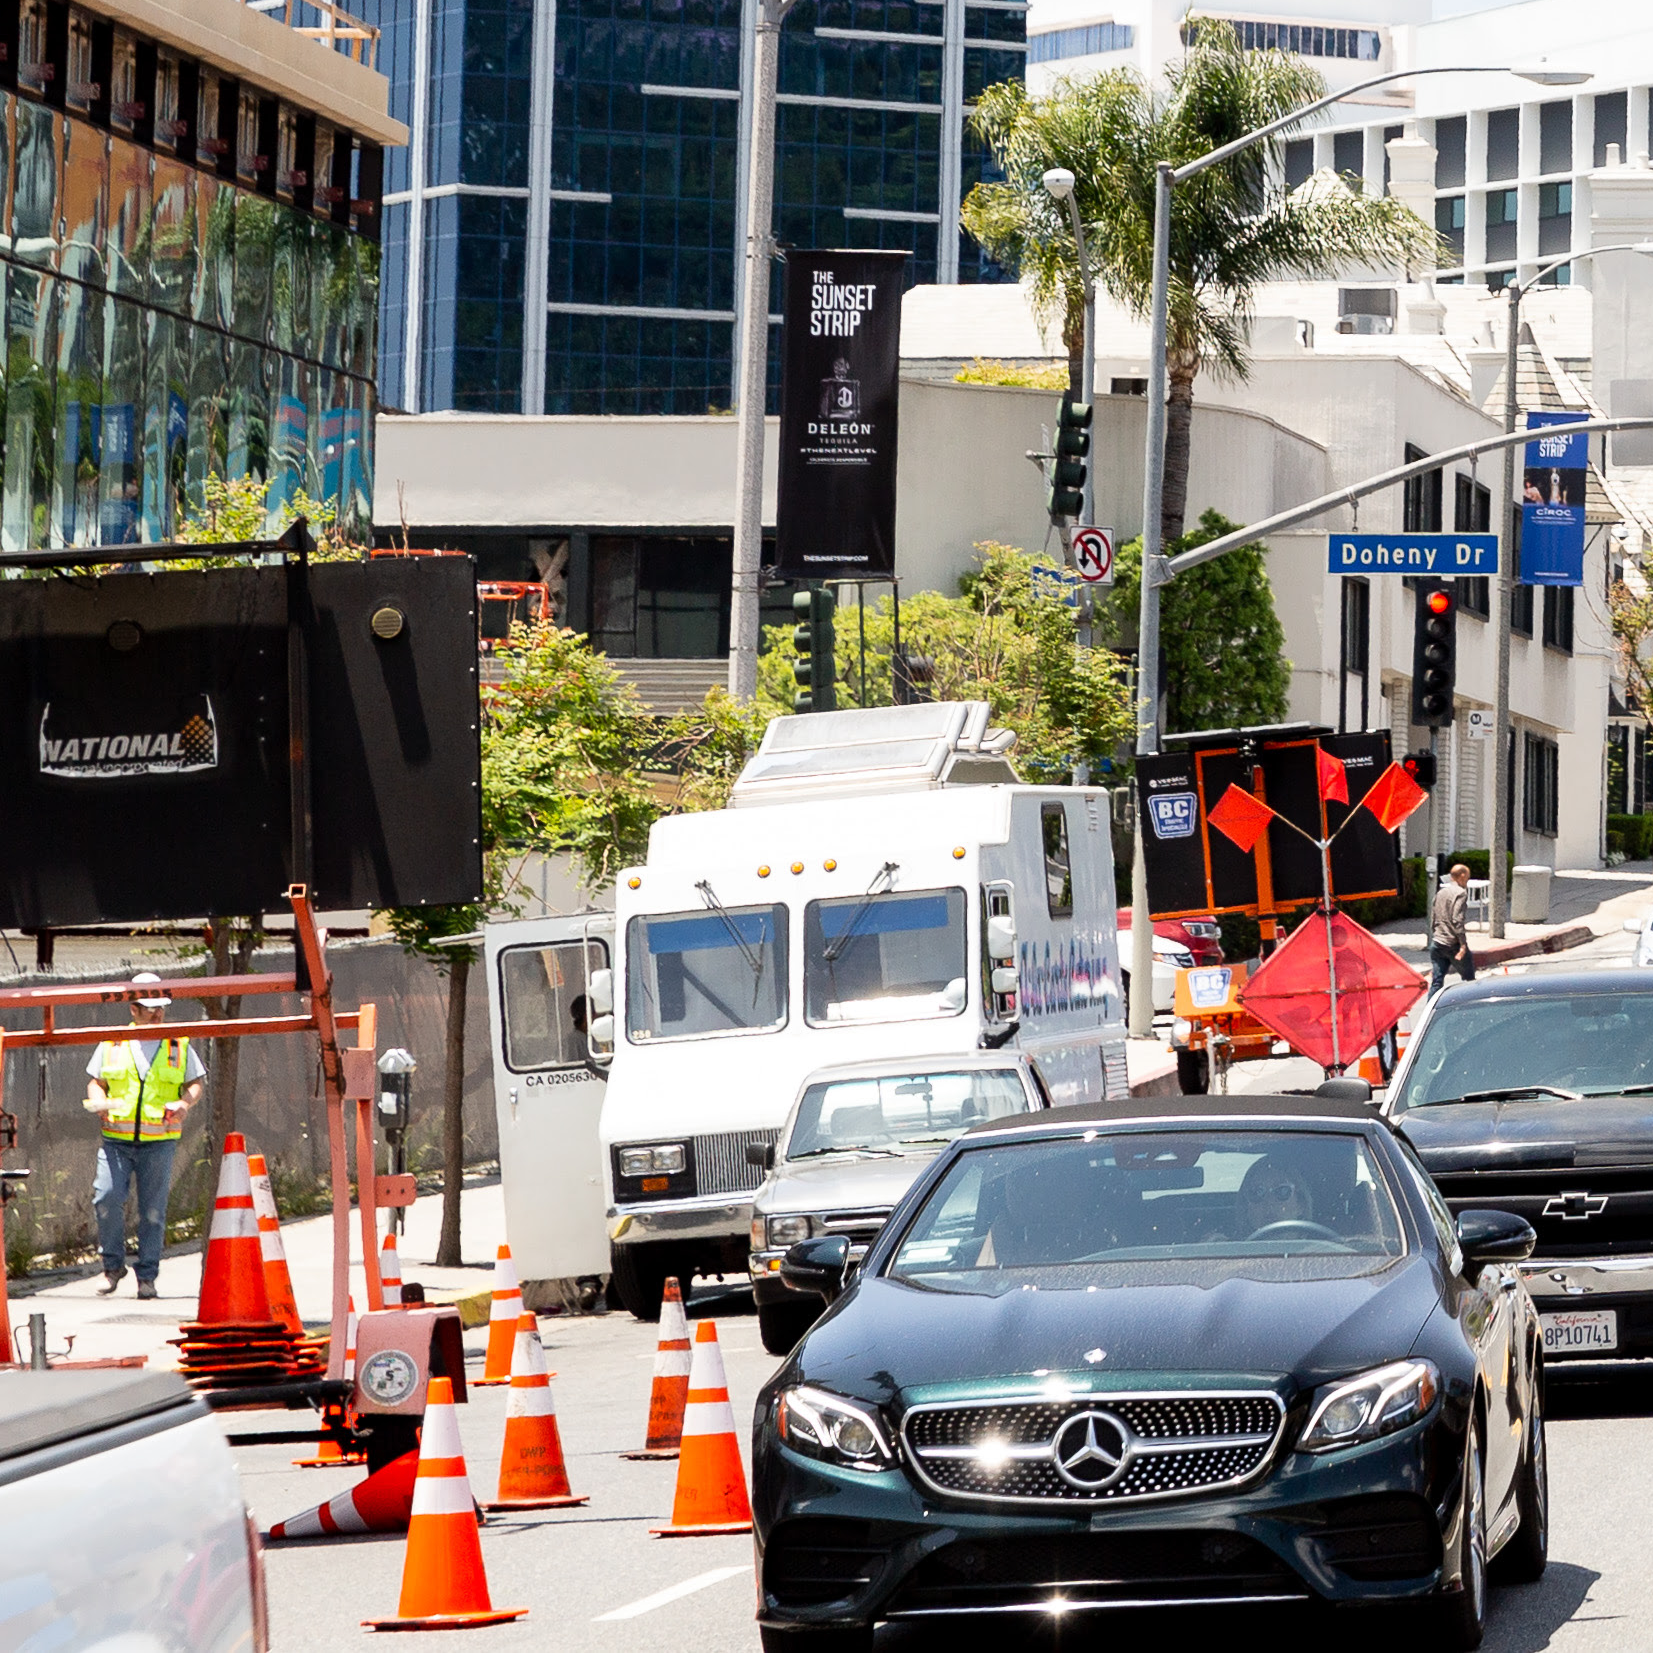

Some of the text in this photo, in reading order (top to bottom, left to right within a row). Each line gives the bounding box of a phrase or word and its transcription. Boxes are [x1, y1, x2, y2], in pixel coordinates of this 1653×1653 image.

[813, 271, 834, 284] THE
[811, 284, 877, 311] SUNSET
[810, 310, 861, 337] STRIP
[1539, 444, 1567, 457] STRIP
[1341, 543, 1485, 570] Doheny Dr
[42, 733, 186, 763] NATIONAL
[1158, 800, 1189, 819] BC
[526, 1075, 545, 1087] CA
[1544, 1324, 1612, 1347] 8P10741
